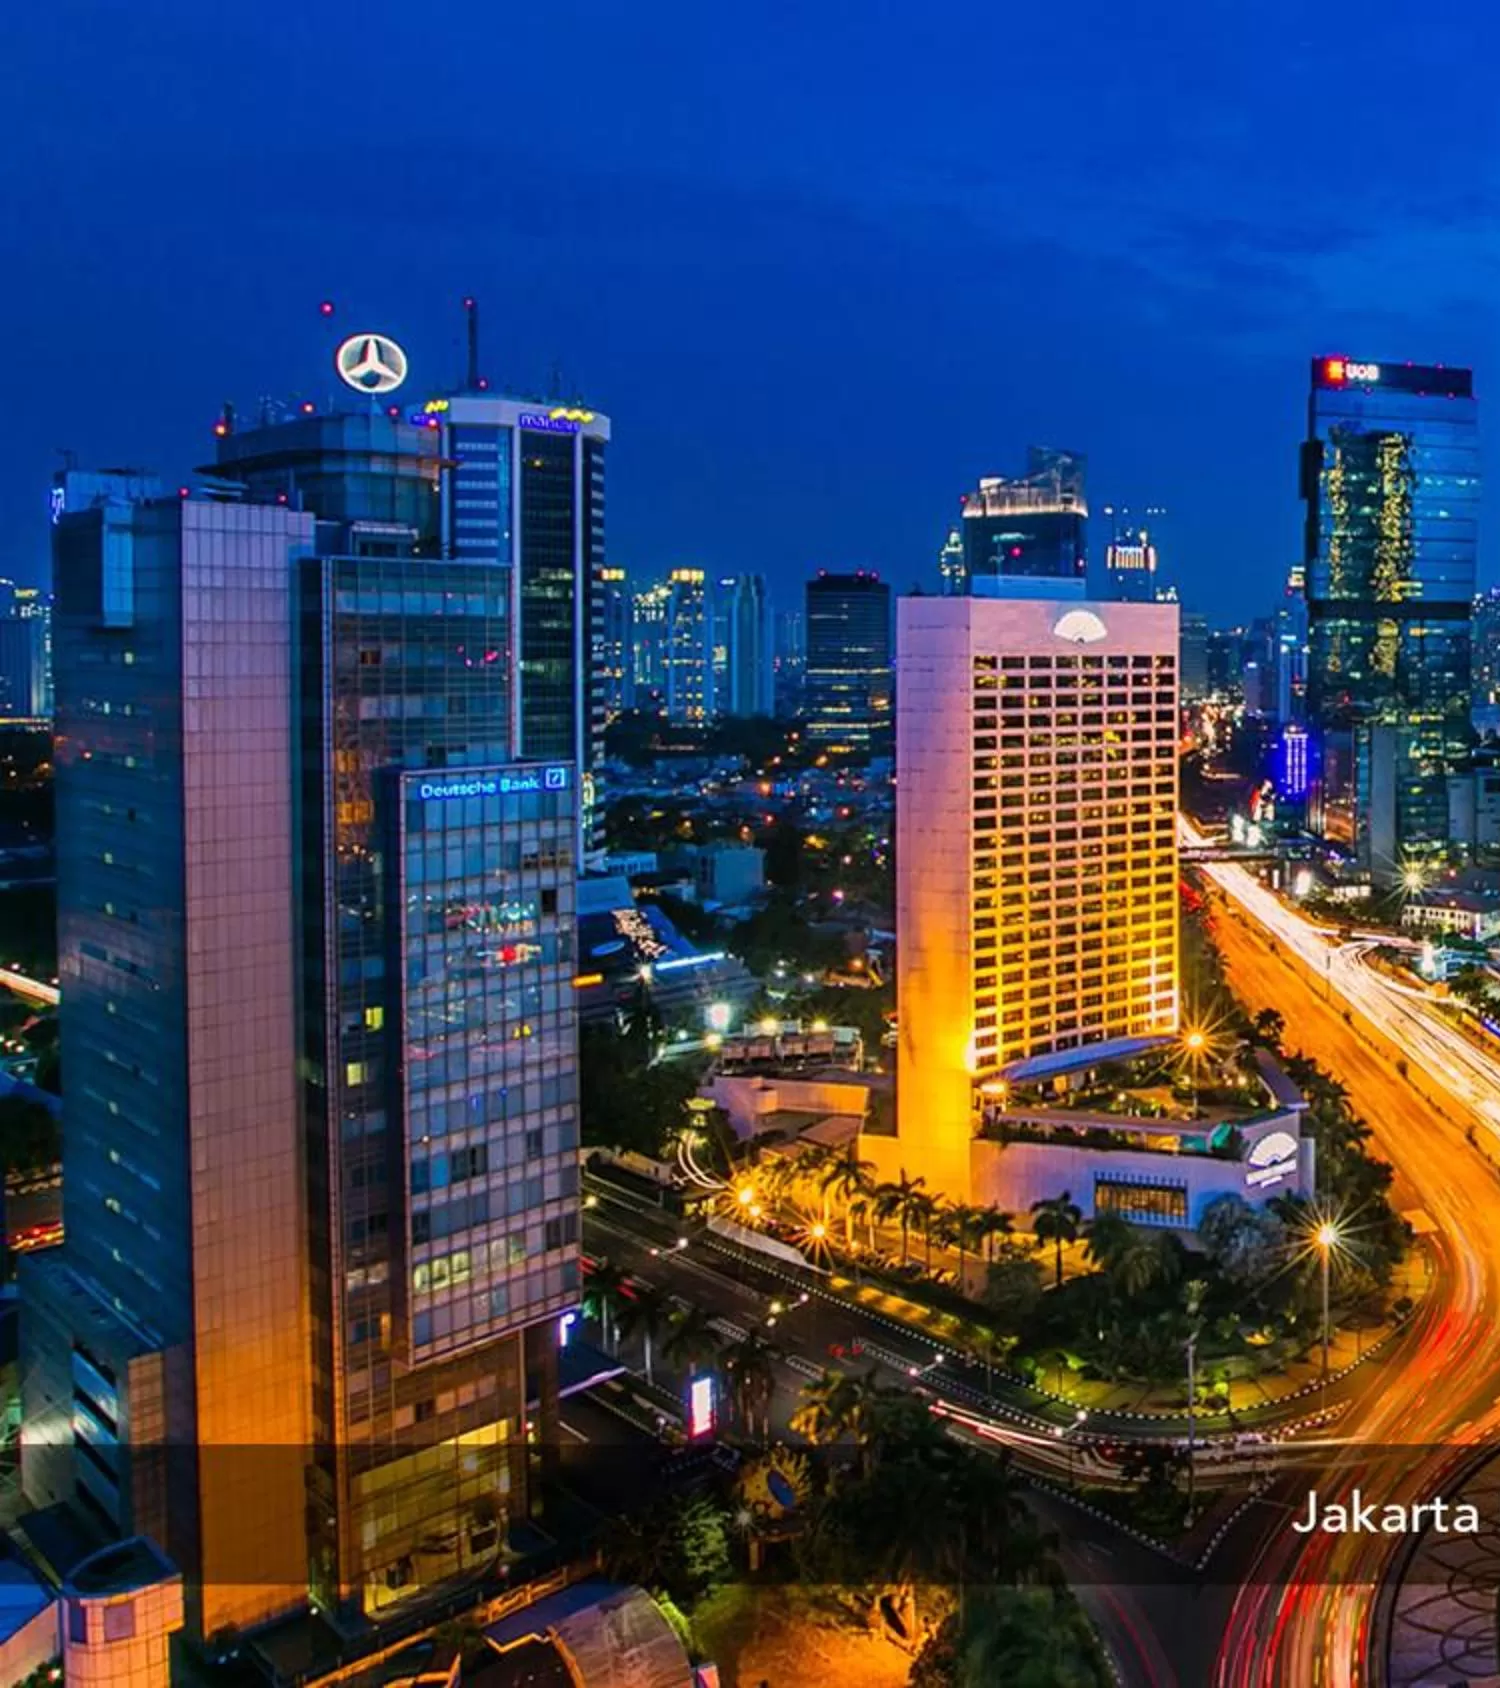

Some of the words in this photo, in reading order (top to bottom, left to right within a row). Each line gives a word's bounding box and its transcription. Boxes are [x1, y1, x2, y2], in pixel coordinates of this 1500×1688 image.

[1346, 363, 1379, 380] UOB
[421, 783, 496, 798] Deutsche
[501, 778, 539, 792] Bank
